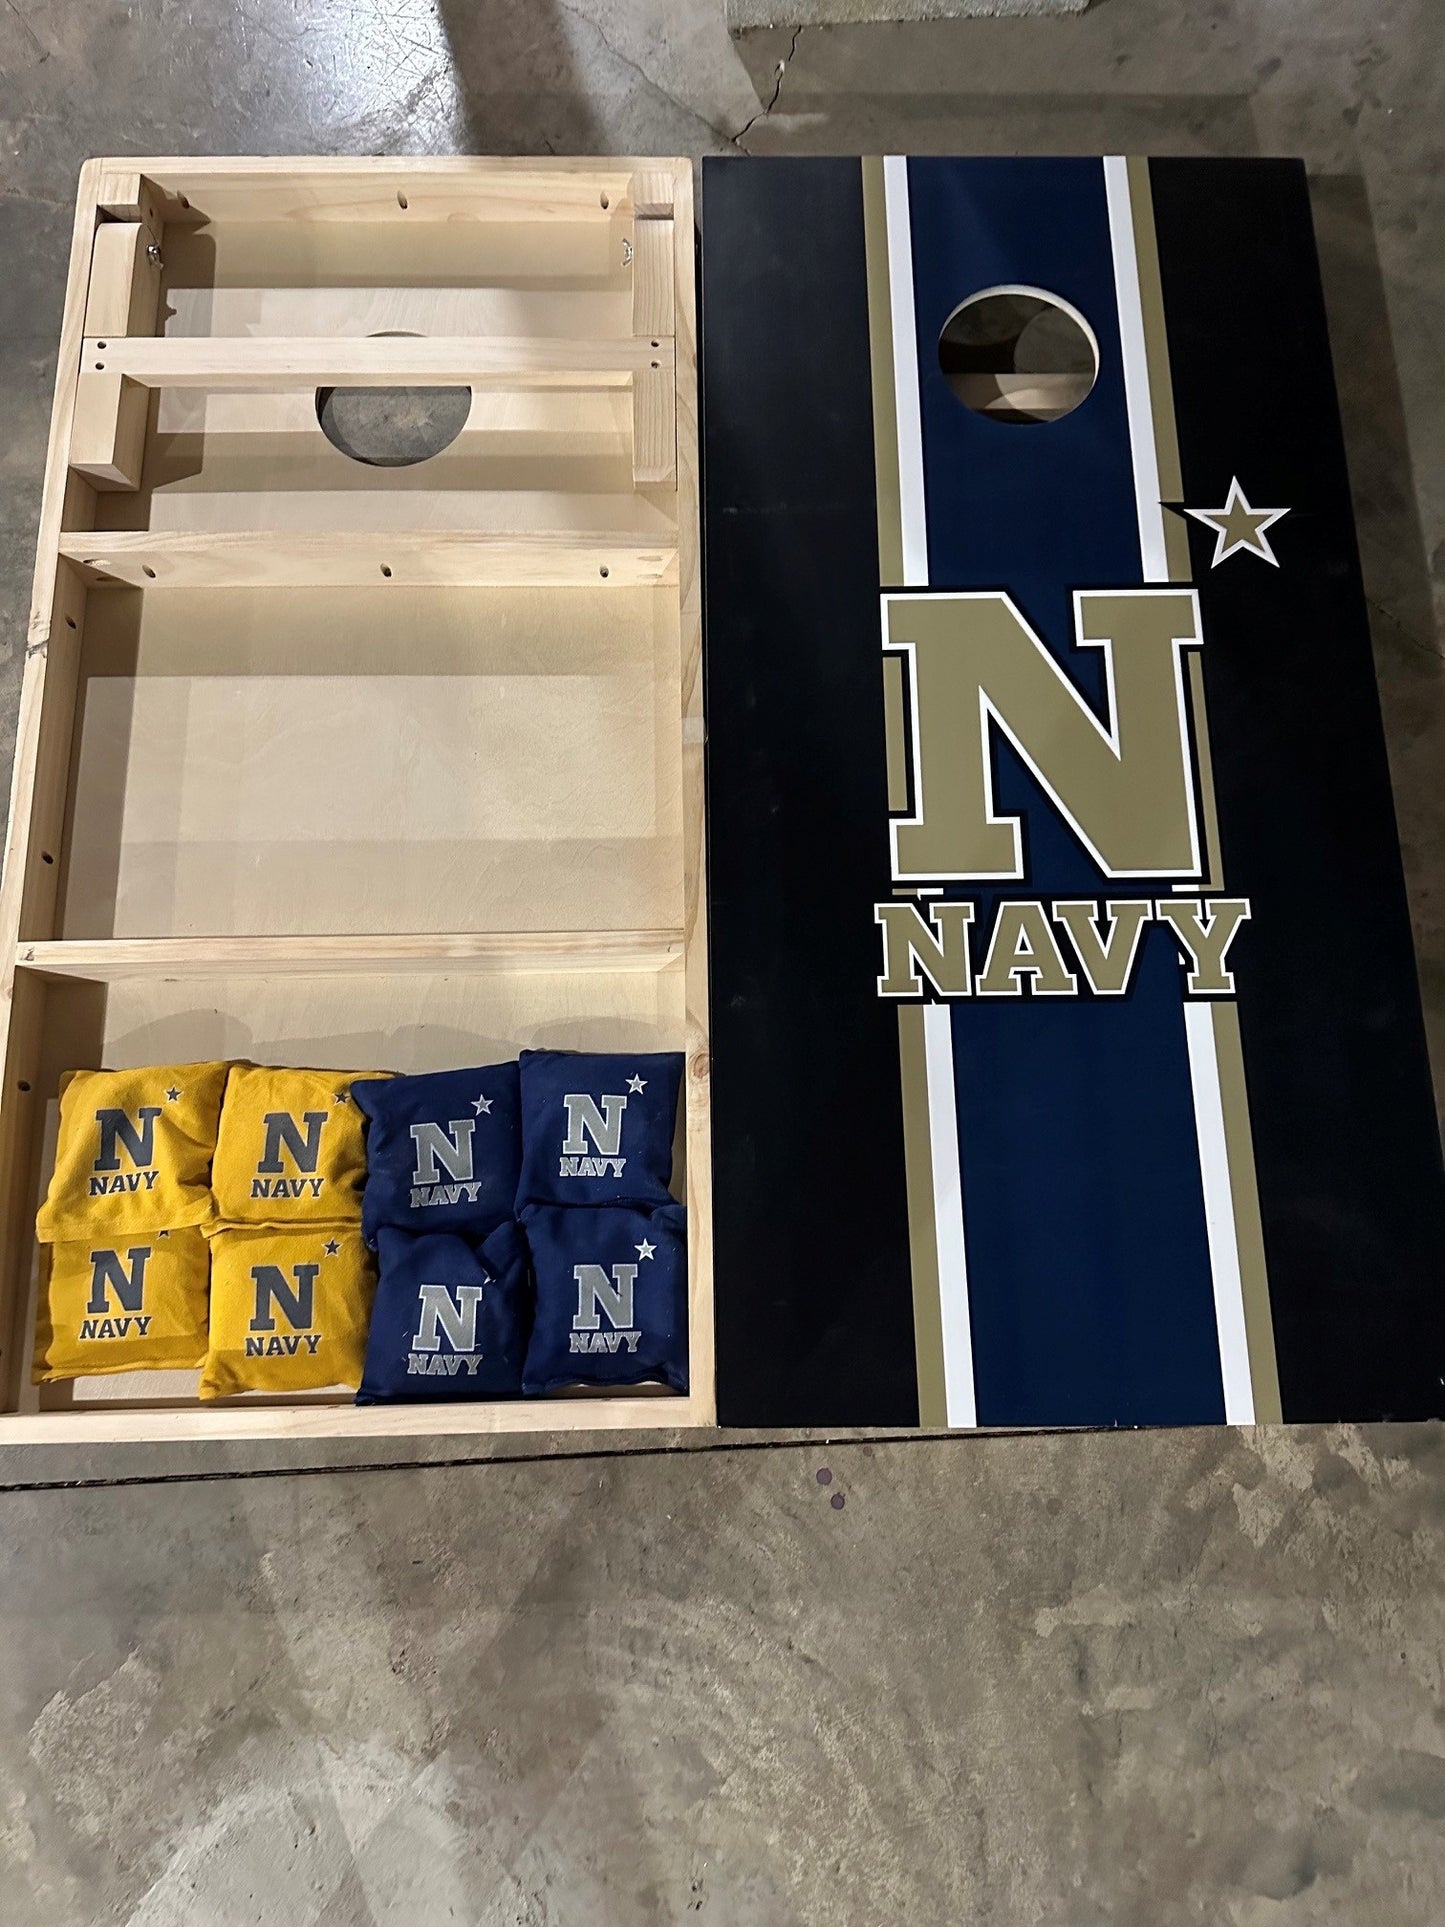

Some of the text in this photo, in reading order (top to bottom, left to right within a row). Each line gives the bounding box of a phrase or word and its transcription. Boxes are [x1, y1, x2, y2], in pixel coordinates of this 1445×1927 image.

[880, 588, 1204, 881] N
[874, 898, 1252, 997] NAVY
[94, 1107, 162, 1172] N
[257, 1111, 329, 1174] N
[410, 1119, 476, 1185] N
[563, 1094, 627, 1156] N
[89, 1170, 160, 1196] NAVY
[250, 1177, 325, 1198] NAVY
[409, 1182, 482, 1208] NAVY
[559, 1157, 627, 1178] NAVY
[87, 1246, 152, 1314] N
[249, 1263, 319, 1332] N
[572, 1263, 638, 1330] N
[79, 1316, 152, 1340] NAVY
[245, 1334, 321, 1357] NAVY
[412, 1284, 482, 1352] N
[569, 1331, 642, 1353] NAVY
[407, 1353, 483, 1375] NAVY
